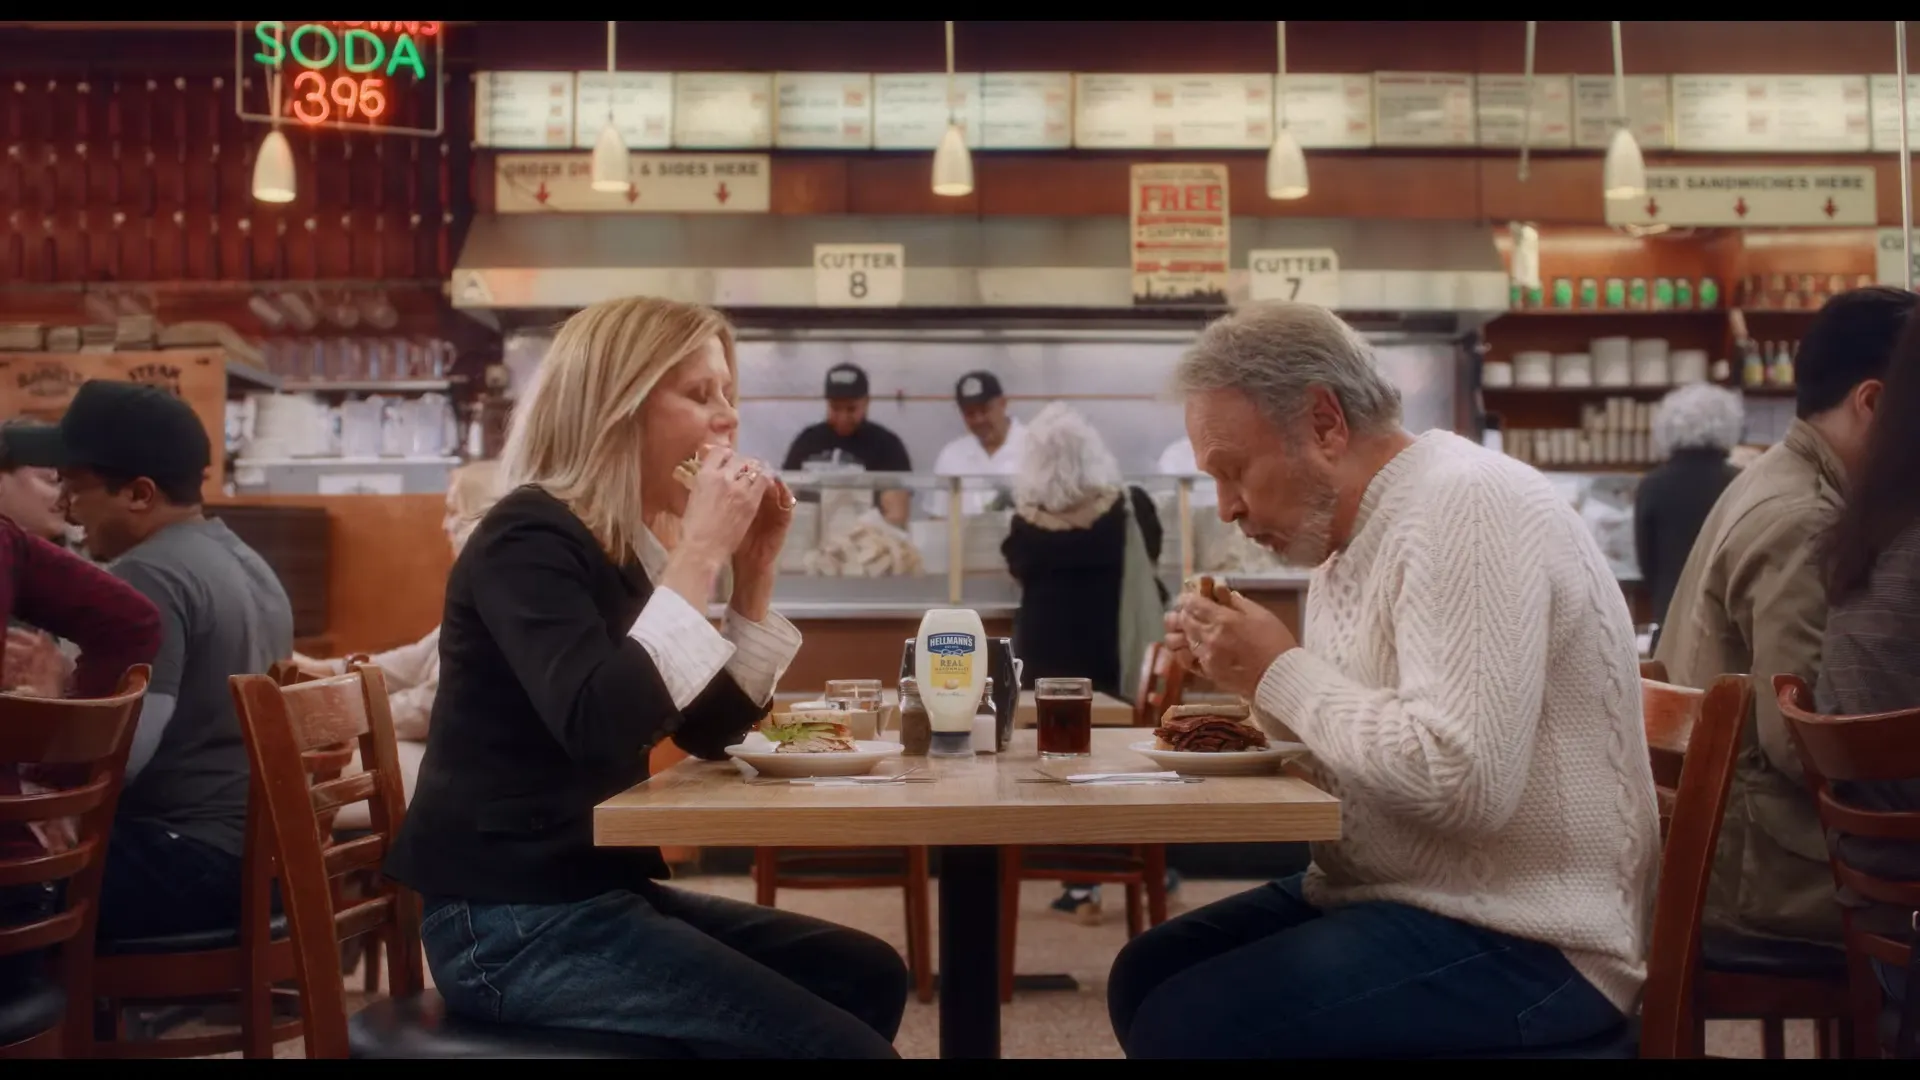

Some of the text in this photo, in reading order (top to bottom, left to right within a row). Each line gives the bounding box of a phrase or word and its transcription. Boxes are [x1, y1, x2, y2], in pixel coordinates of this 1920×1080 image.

[254, 21, 426, 79] SODA
[293, 71, 386, 124] 395
[504, 162, 562, 177] ORDER
[640, 162, 652, 176] &
[658, 162, 708, 177] SIDES
[713, 162, 760, 177] HERE
[1686, 175, 1809, 190] SANDWICHES
[1814, 175, 1865, 190] HERE
[1140, 184, 1223, 212] FREE
[820, 252, 896, 269] CUTTER
[1254, 256, 1331, 272] CUTTER
[849, 271, 867, 299] 8
[1286, 277, 1301, 301] 7
[929, 636, 973, 647] HELLMANN'S
[940, 659, 964, 667] REAL
